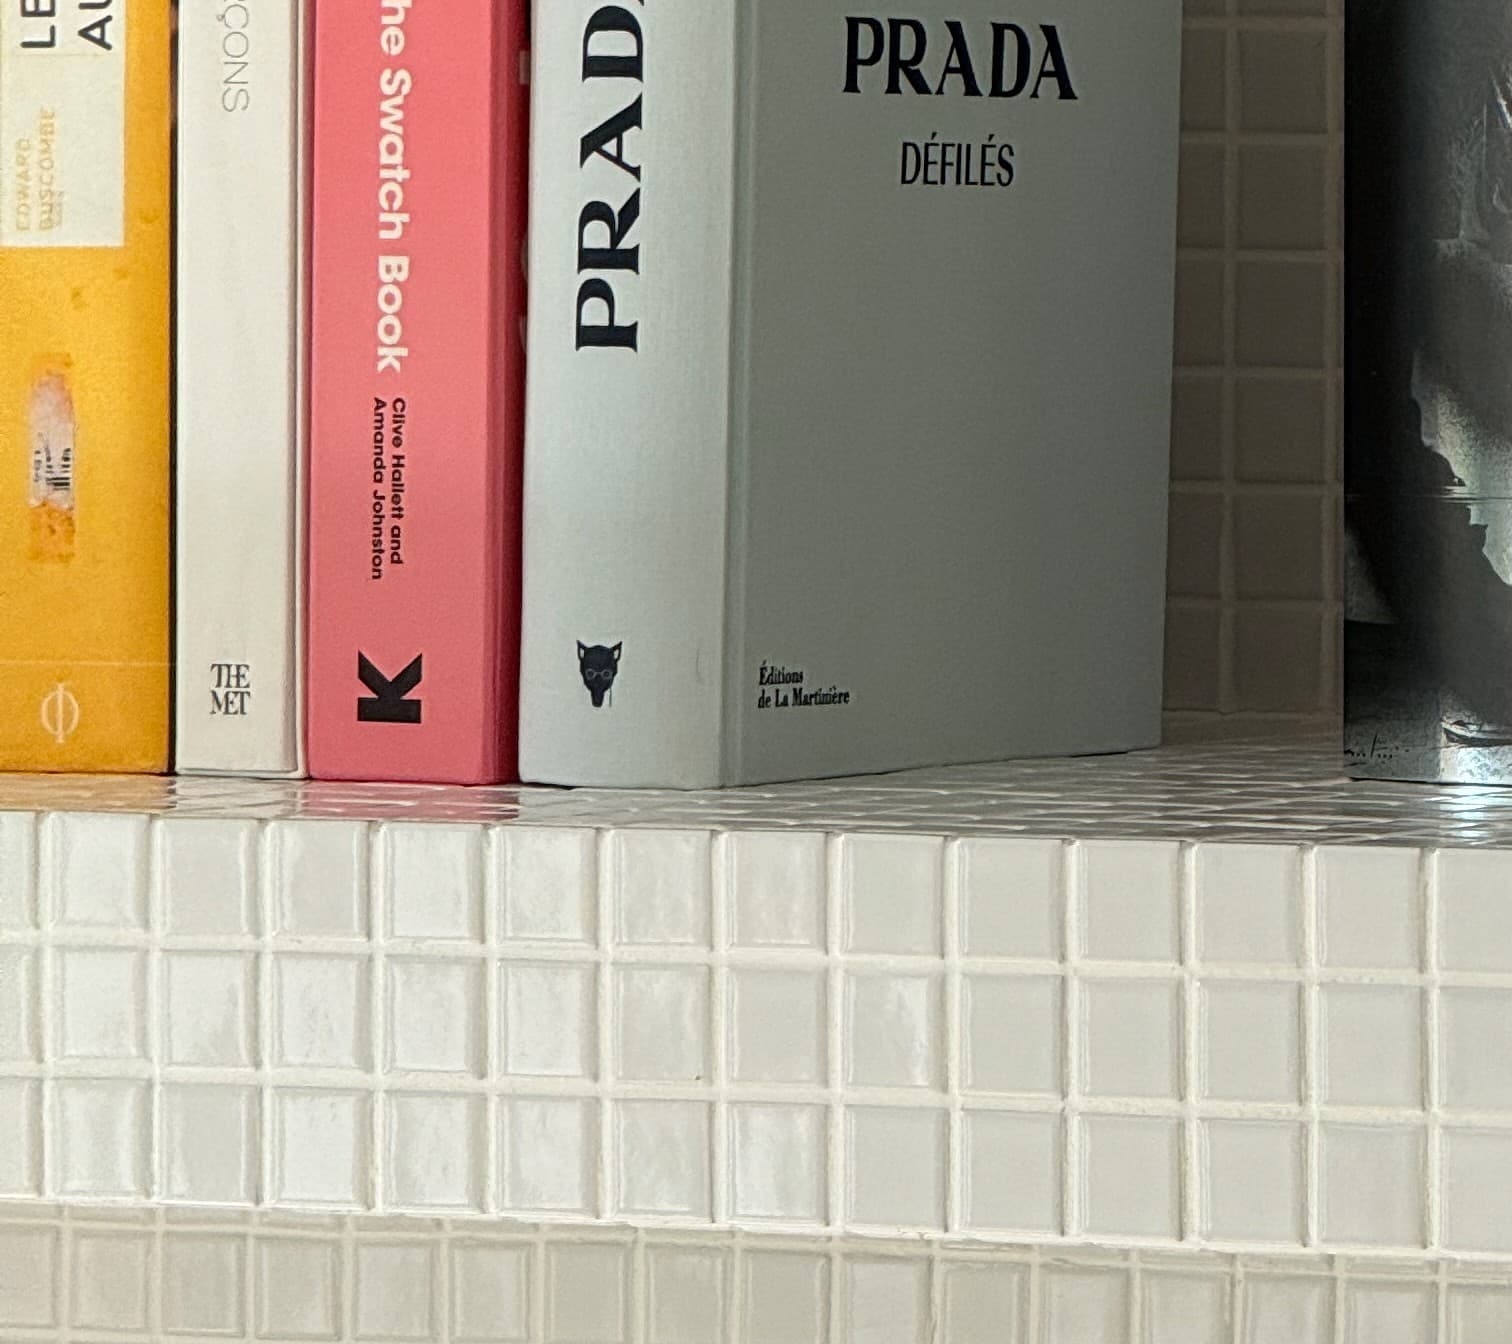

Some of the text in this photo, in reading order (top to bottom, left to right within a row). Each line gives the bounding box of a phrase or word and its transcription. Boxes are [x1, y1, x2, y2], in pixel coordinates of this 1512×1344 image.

[842, 16, 1079, 100] PRADA
[378, 68, 413, 240] Swatch
[901, 132, 1015, 187] DÉFILÉS
[376, 255, 410, 374] Book
[371, 397, 388, 580] Amanda Johnston
[390, 397, 406, 565] Clive Hallett and
[210, 663, 251, 688] THE
[210, 690, 251, 716] MET
[758, 685, 850, 709] de La Martinière
[759, 659, 804, 686] Éditions
